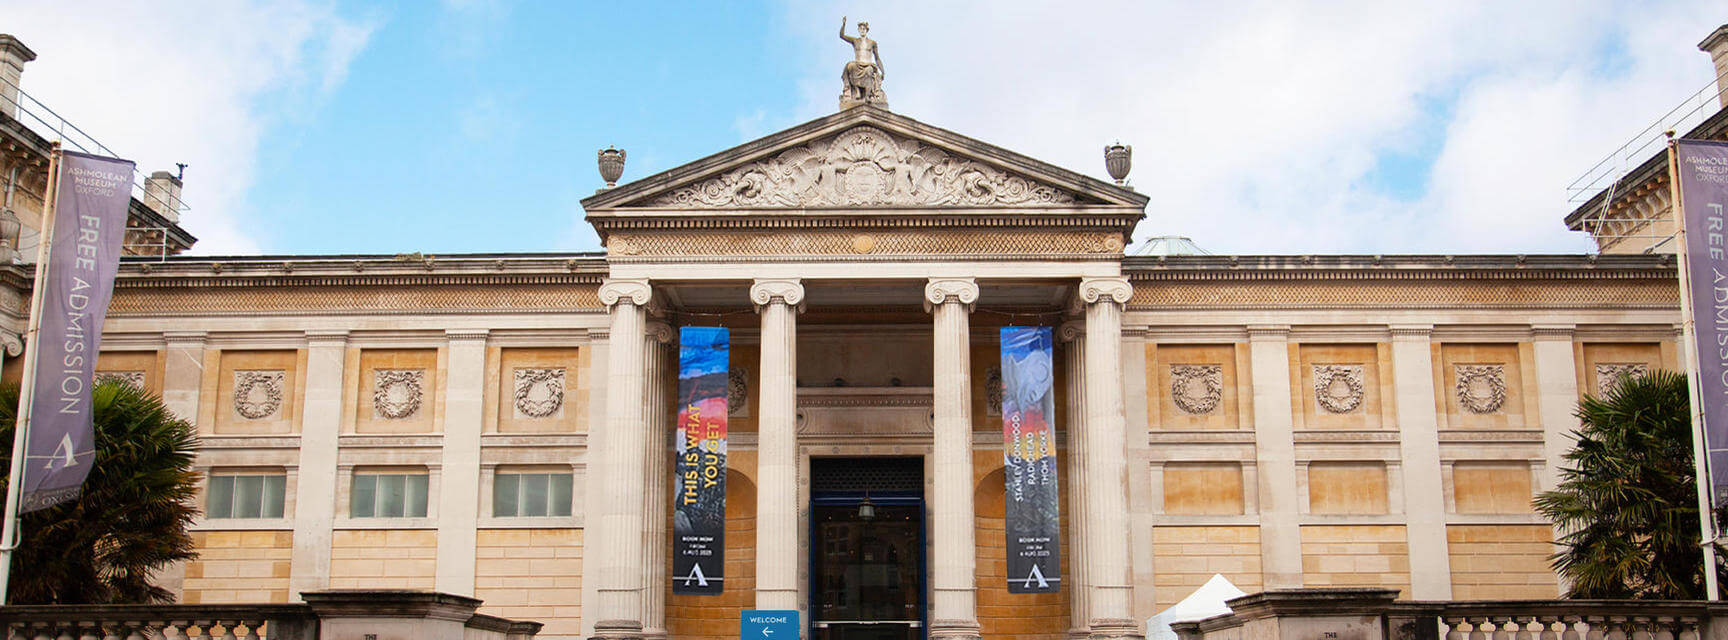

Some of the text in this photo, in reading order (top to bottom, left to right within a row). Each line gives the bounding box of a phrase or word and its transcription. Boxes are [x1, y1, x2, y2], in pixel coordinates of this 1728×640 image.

[68, 167, 127, 182] ASHMOLEAN
[75, 176, 117, 190] MUSEUM
[75, 184, 114, 197] OXFORD
[1706, 202, 1724, 261] FREE
[59, 214, 100, 414] FREE ADMISSION
[684, 404, 701, 506] THIS IS WHAT
[704, 422, 720, 489] YOU GET
[1011, 414, 1024, 502] STANLEY DONWOOD
[1026, 432, 1036, 485] RADIOHEAD
[1039, 430, 1049, 485] THOM YORKE
[684, 562, 709, 586] A
[1023, 563, 1050, 588] A
[749, 616, 787, 624] WELCOME
